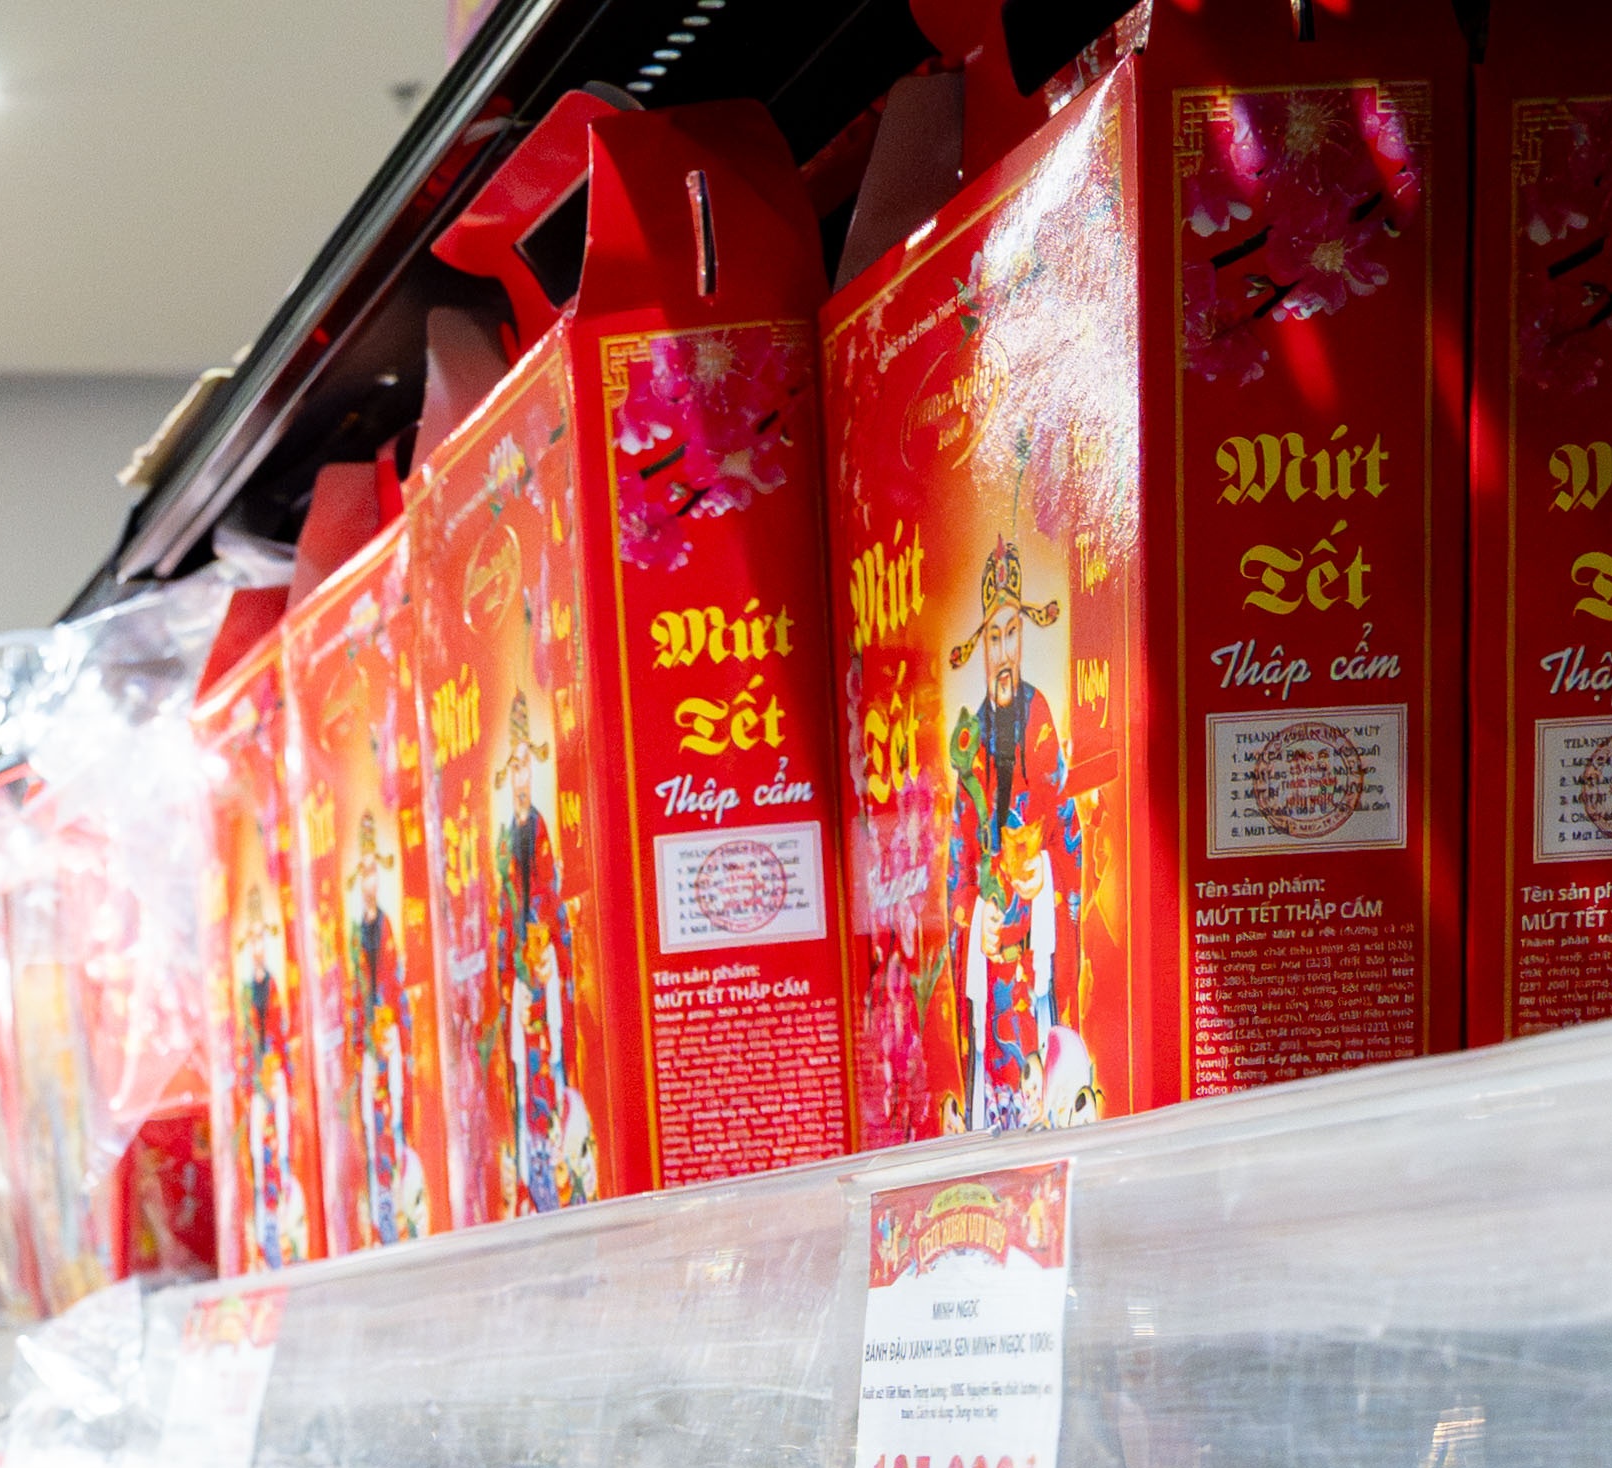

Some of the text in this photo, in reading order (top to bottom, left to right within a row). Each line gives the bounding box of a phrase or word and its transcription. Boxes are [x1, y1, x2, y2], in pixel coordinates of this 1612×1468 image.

[1216, 424, 1390, 505] Mứt
[850, 519, 925, 655] Mứt
[1239, 519, 1372, 615] Tết
[650, 597, 794, 669] Mứt
[1209, 621, 1401, 701] Thập cẩm
[675, 674, 785, 756] Tết
[864, 659, 920, 804] Tết
[655, 756, 815, 824] Thập cẩm
[1195, 874, 1326, 900] Tên sản phẩm:
[1196, 895, 1383, 927] MỨT TẾT THẬP CẨM
[1520, 884, 1555, 904] Tên
[1558, 881, 1591, 903] sản
[1521, 909, 1570, 932] MỨT
[1572, 905, 1608, 929] TẾT
[653, 970, 681, 987] Tên
[683, 966, 711, 986] sản
[654, 976, 811, 1010] MỨT TẾT THẬP CẨM
[865, 1340, 888, 1362] BÁNH
[889, 1337, 907, 1364] ĐẬU
[908, 1338, 933, 1361] XANH
[954, 1336, 970, 1357] SEN
